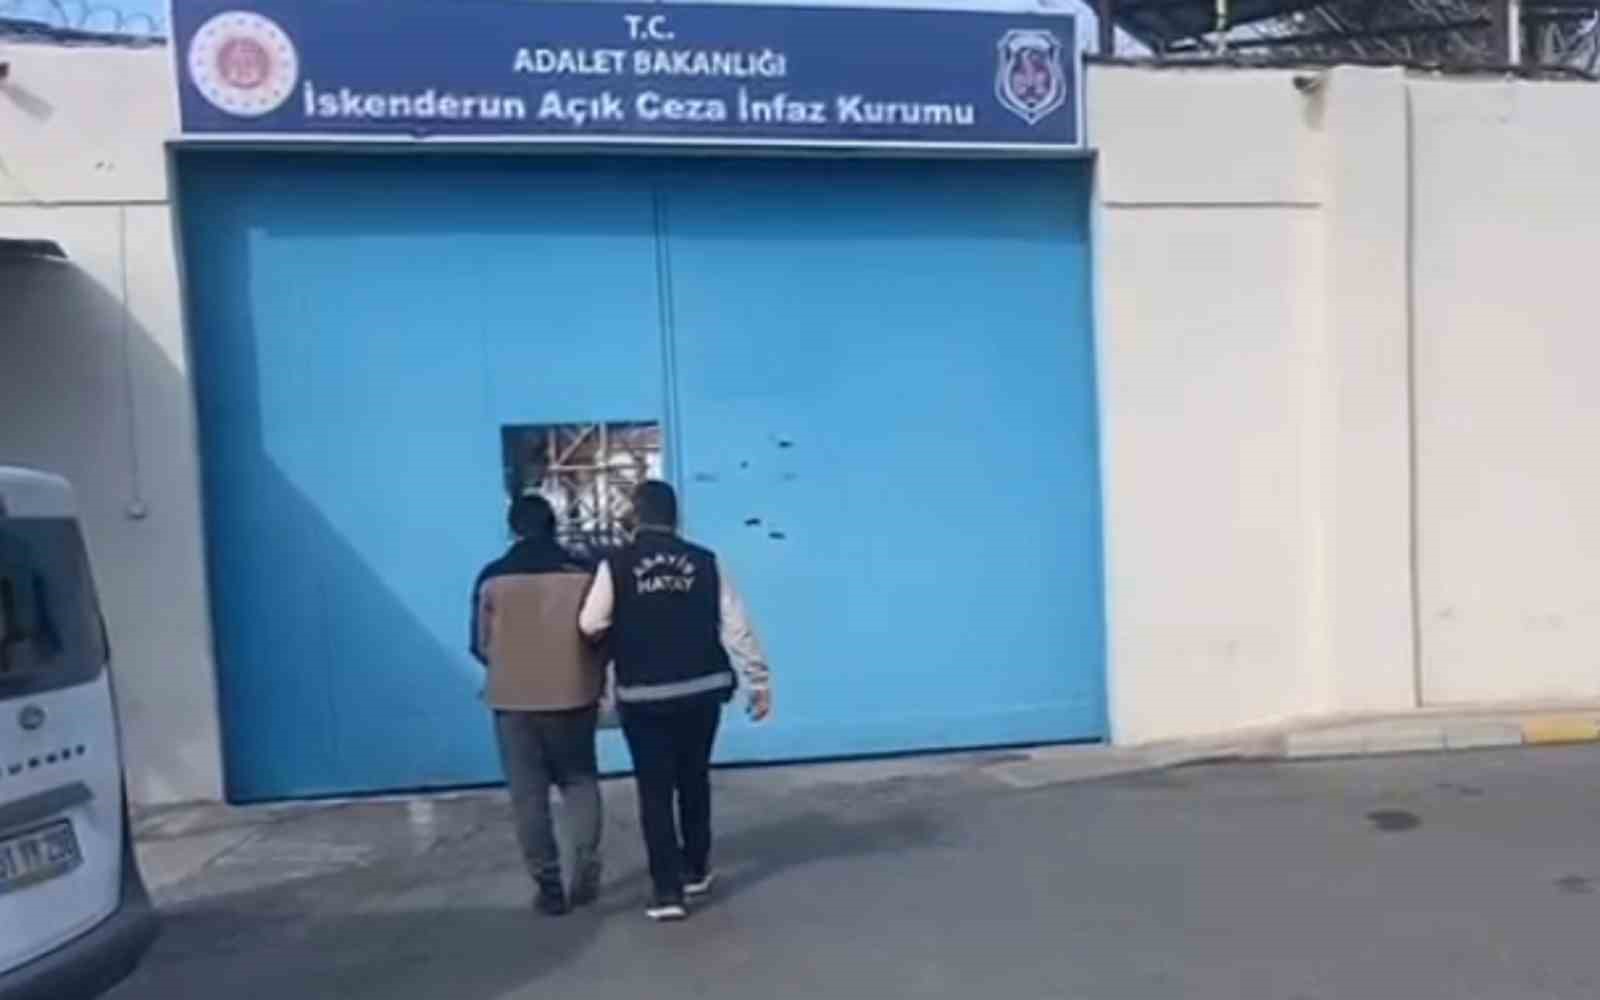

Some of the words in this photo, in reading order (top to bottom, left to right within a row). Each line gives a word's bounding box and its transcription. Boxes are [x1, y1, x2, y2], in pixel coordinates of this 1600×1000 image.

[624, 15, 675, 40] T.C.
[514, 49, 626, 74] ADALET
[634, 49, 787, 77] BAKANLIĞI
[303, 80, 525, 118] İskenderun
[537, 91, 625, 124] Açık
[635, 94, 726, 121] Ceza
[738, 88, 827, 124] İnfaz
[837, 98, 975, 126] Kurumu
[637, 575, 695, 593] HATAY
